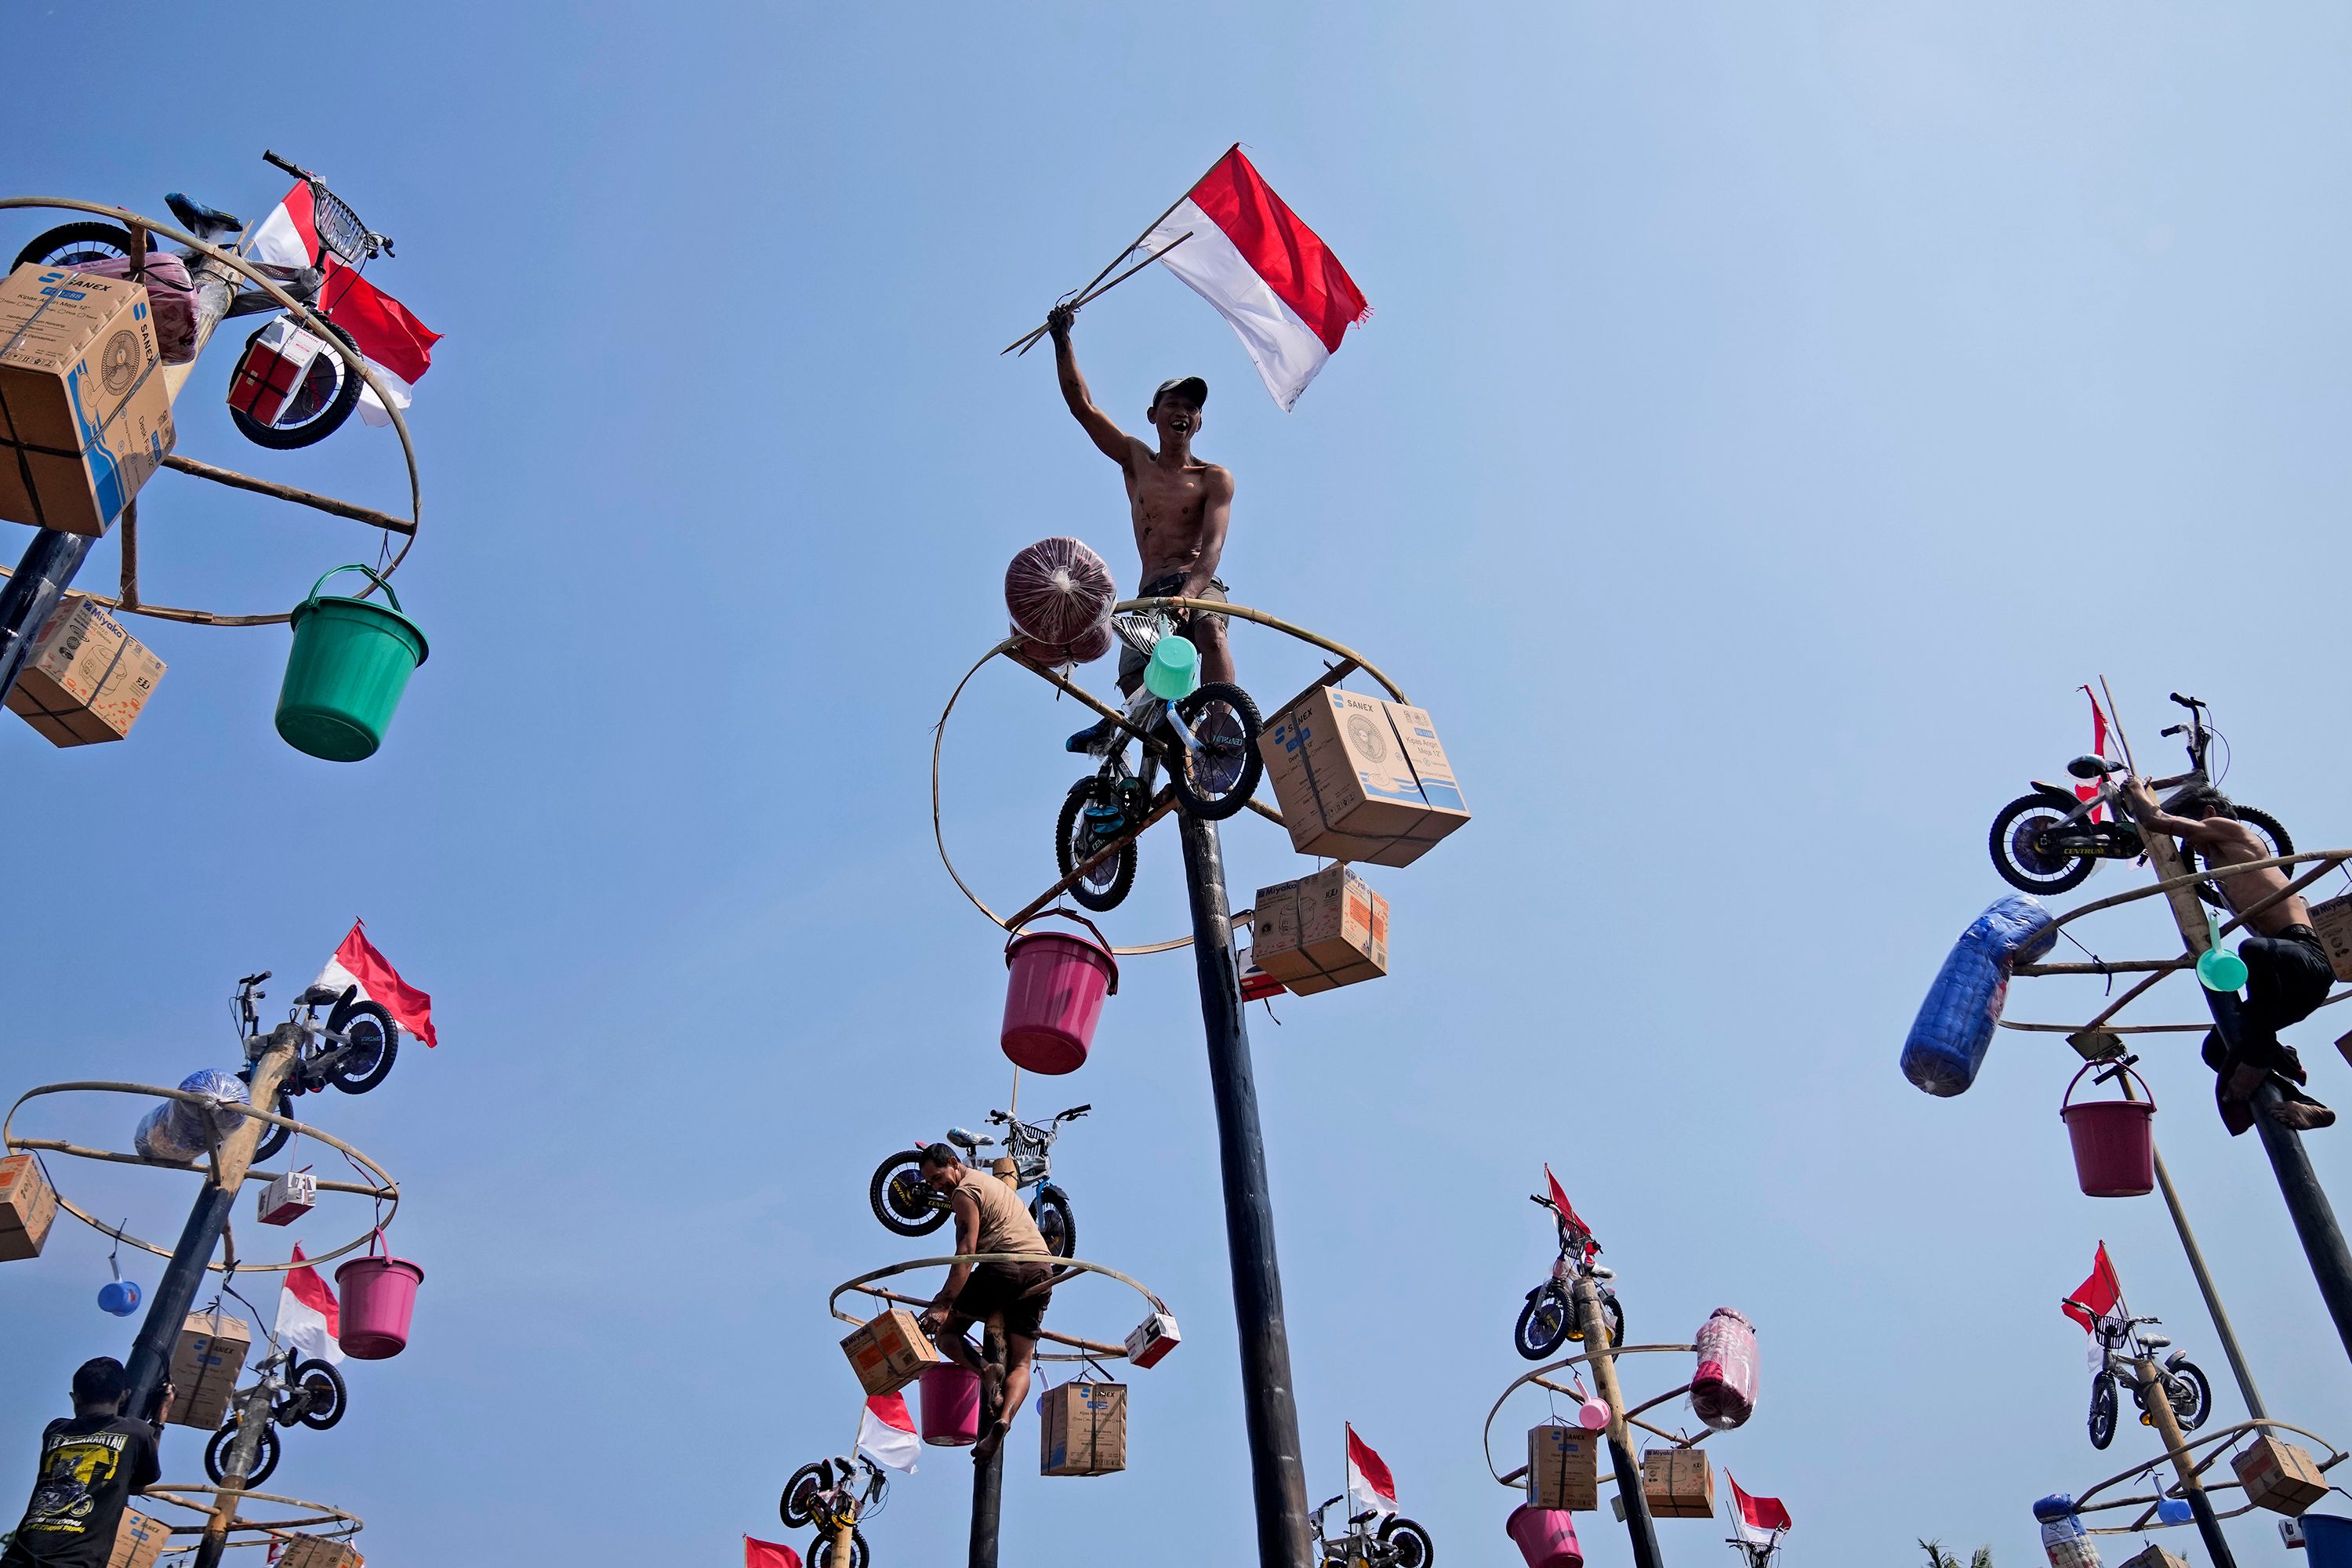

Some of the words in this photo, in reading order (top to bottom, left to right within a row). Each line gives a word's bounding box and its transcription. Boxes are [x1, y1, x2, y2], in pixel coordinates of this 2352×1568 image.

[140, 324, 154, 365] SANEX
[138, 416, 147, 439] Desk
[91, 608, 122, 638] Miyako
[1348, 699, 1374, 712] SANEX
[1287, 707, 1313, 733] SNEX
[1406, 737, 1422, 746] Kipas
[1423, 739, 1439, 750] Angin
[1417, 746, 1432, 757] Meja
[1265, 883, 1297, 895] Miyako
[2321, 897, 2348, 913] Miyak
[213, 1345, 234, 1355] ANEX
